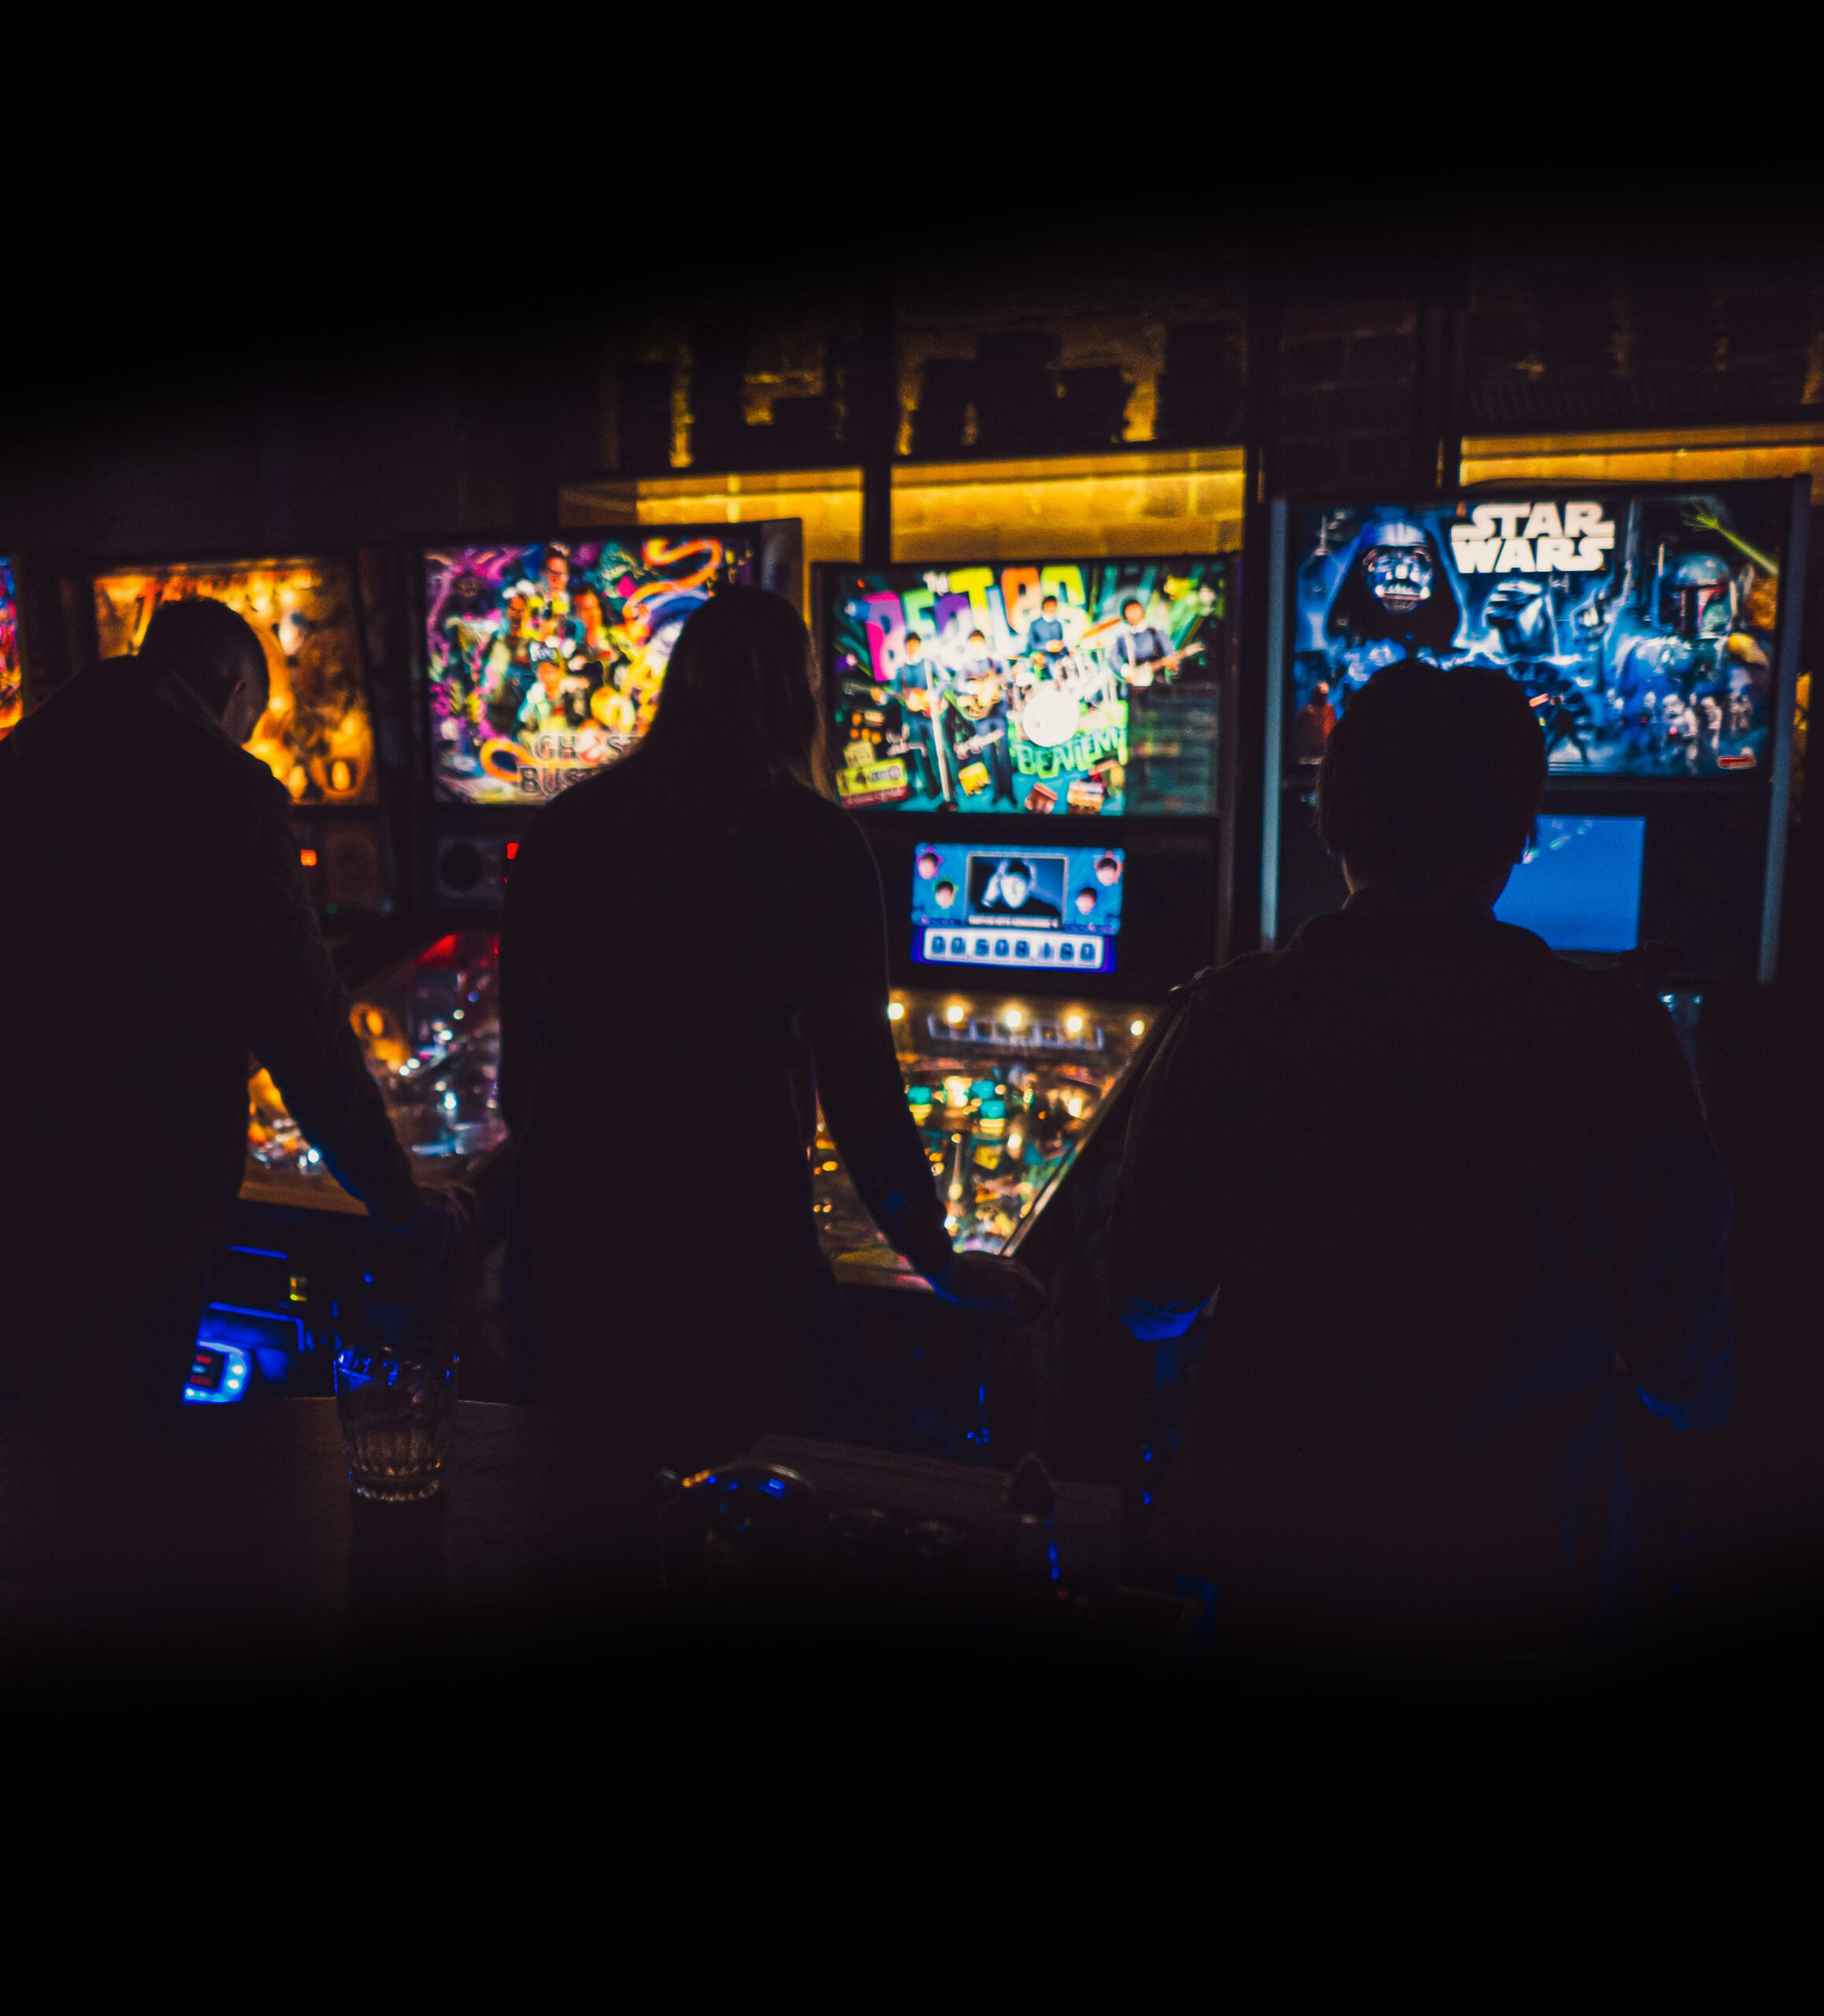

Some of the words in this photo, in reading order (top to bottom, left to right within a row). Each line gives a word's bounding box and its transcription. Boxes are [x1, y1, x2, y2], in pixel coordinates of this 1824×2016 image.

[1451, 501, 1615, 539] STAR
[1451, 537, 1615, 574] WARS
[863, 565, 1093, 683] BEATLES
[517, 765, 592, 797] BUS
